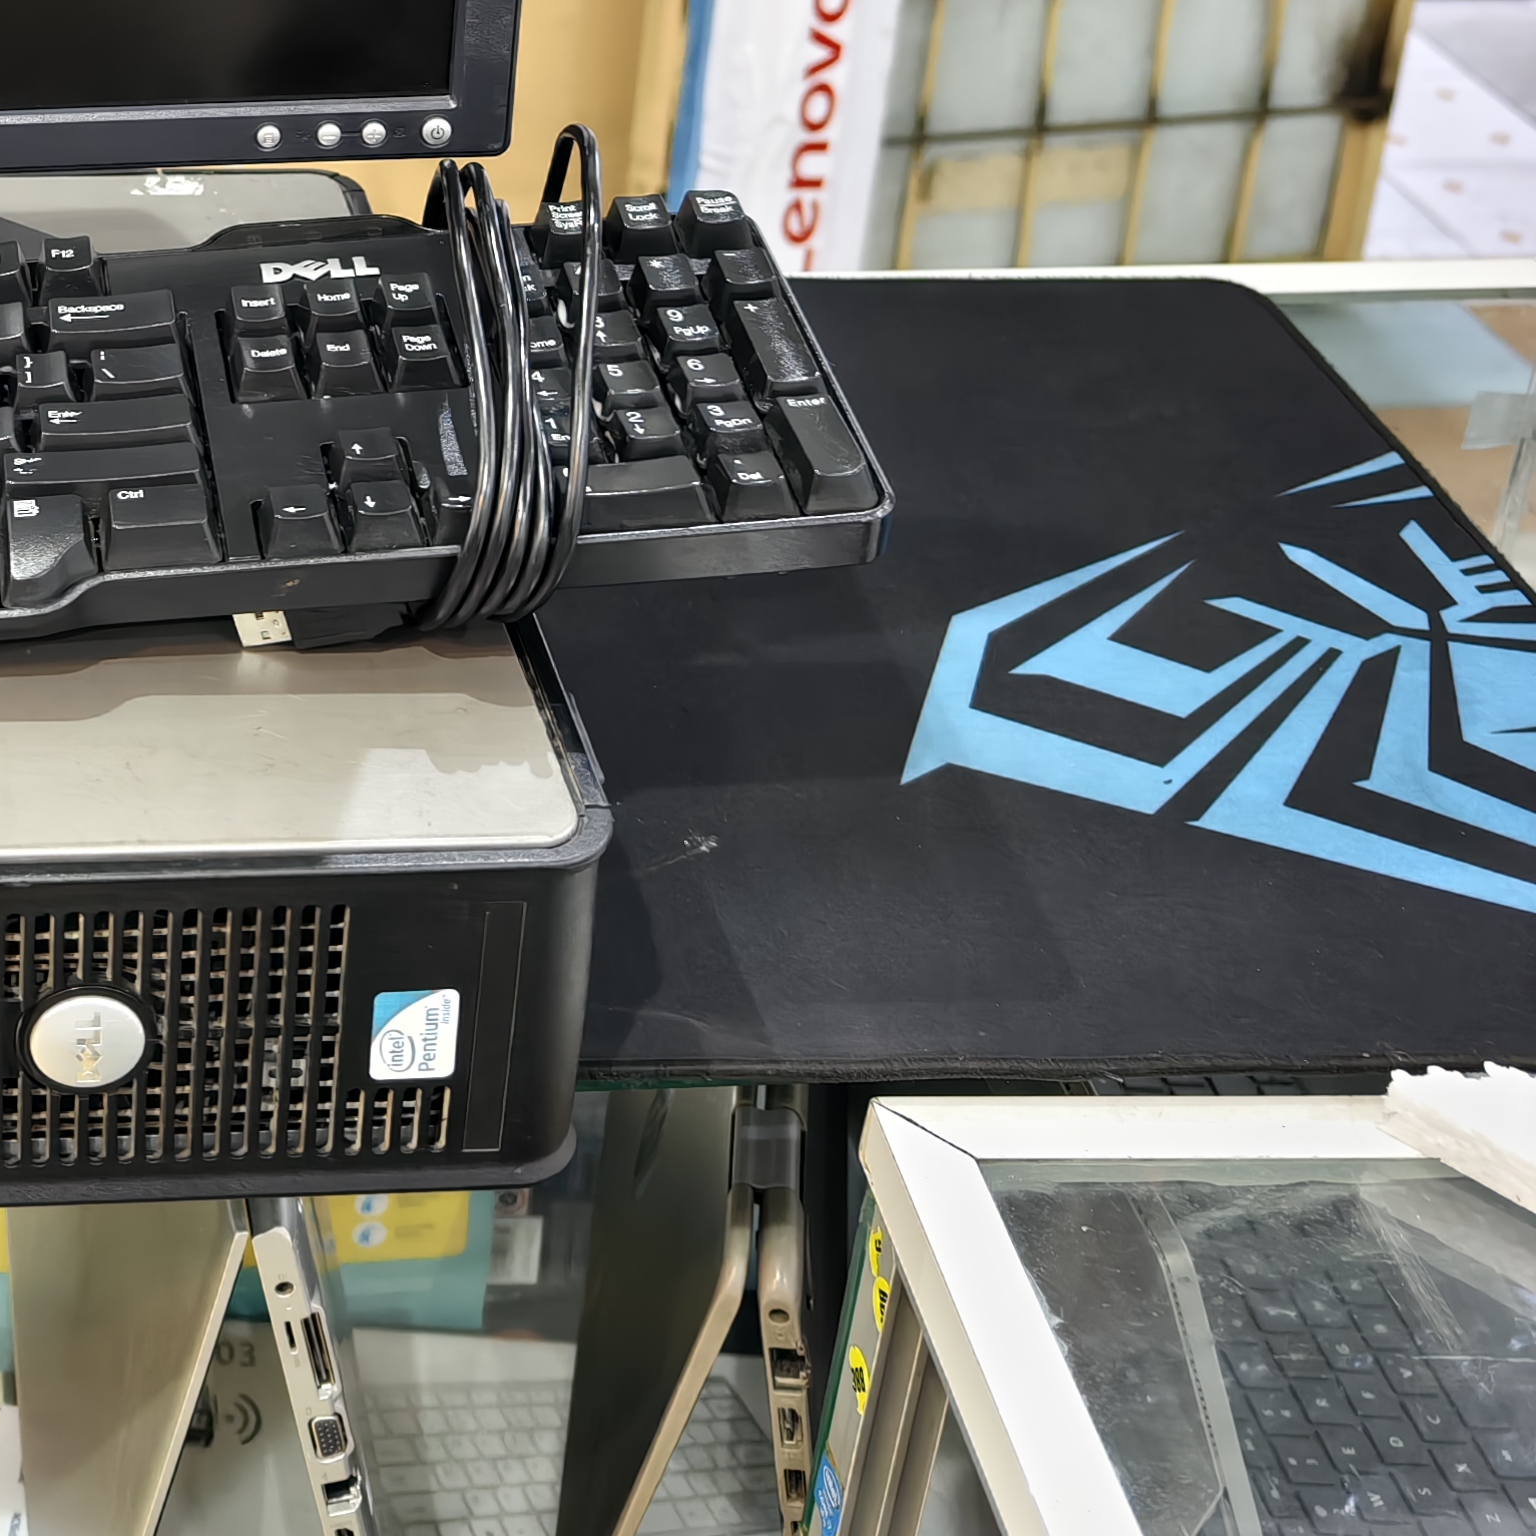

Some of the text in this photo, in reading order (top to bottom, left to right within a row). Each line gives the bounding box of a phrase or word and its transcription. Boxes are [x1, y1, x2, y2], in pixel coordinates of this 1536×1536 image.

[624, 202, 657, 212] Scroll
[700, 205, 733, 213] Break
[627, 212, 659, 221] Lock
[50, 248, 75, 258] F12
[259, 256, 381, 284] DELL
[389, 283, 420, 293] Page
[316, 292, 351, 302] Home
[391, 292, 409, 302] Up
[241, 297, 276, 308] Insert
[57, 303, 125, 314] Backspace
[666, 309, 684, 322] 9
[672, 325, 711, 337] PgUp
[401, 335, 432, 345] Page
[326, 343, 351, 352] End
[404, 342, 438, 352] Down
[250, 348, 288, 358] Delete
[686, 358, 705, 371] 6
[606, 364, 623, 377] 5
[786, 397, 825, 407] Enter
[706, 404, 725, 417] 3
[625, 411, 645, 423] 2
[713, 418, 753, 428] PgDn
[550, 433, 571, 441] En
[737, 471, 764, 481] Del
[116, 489, 144, 500] Ctrl
[418, 1007, 441, 1072] Pentium
[76, 1012, 102, 1083] DELL
[388, 1033, 405, 1067] intel
